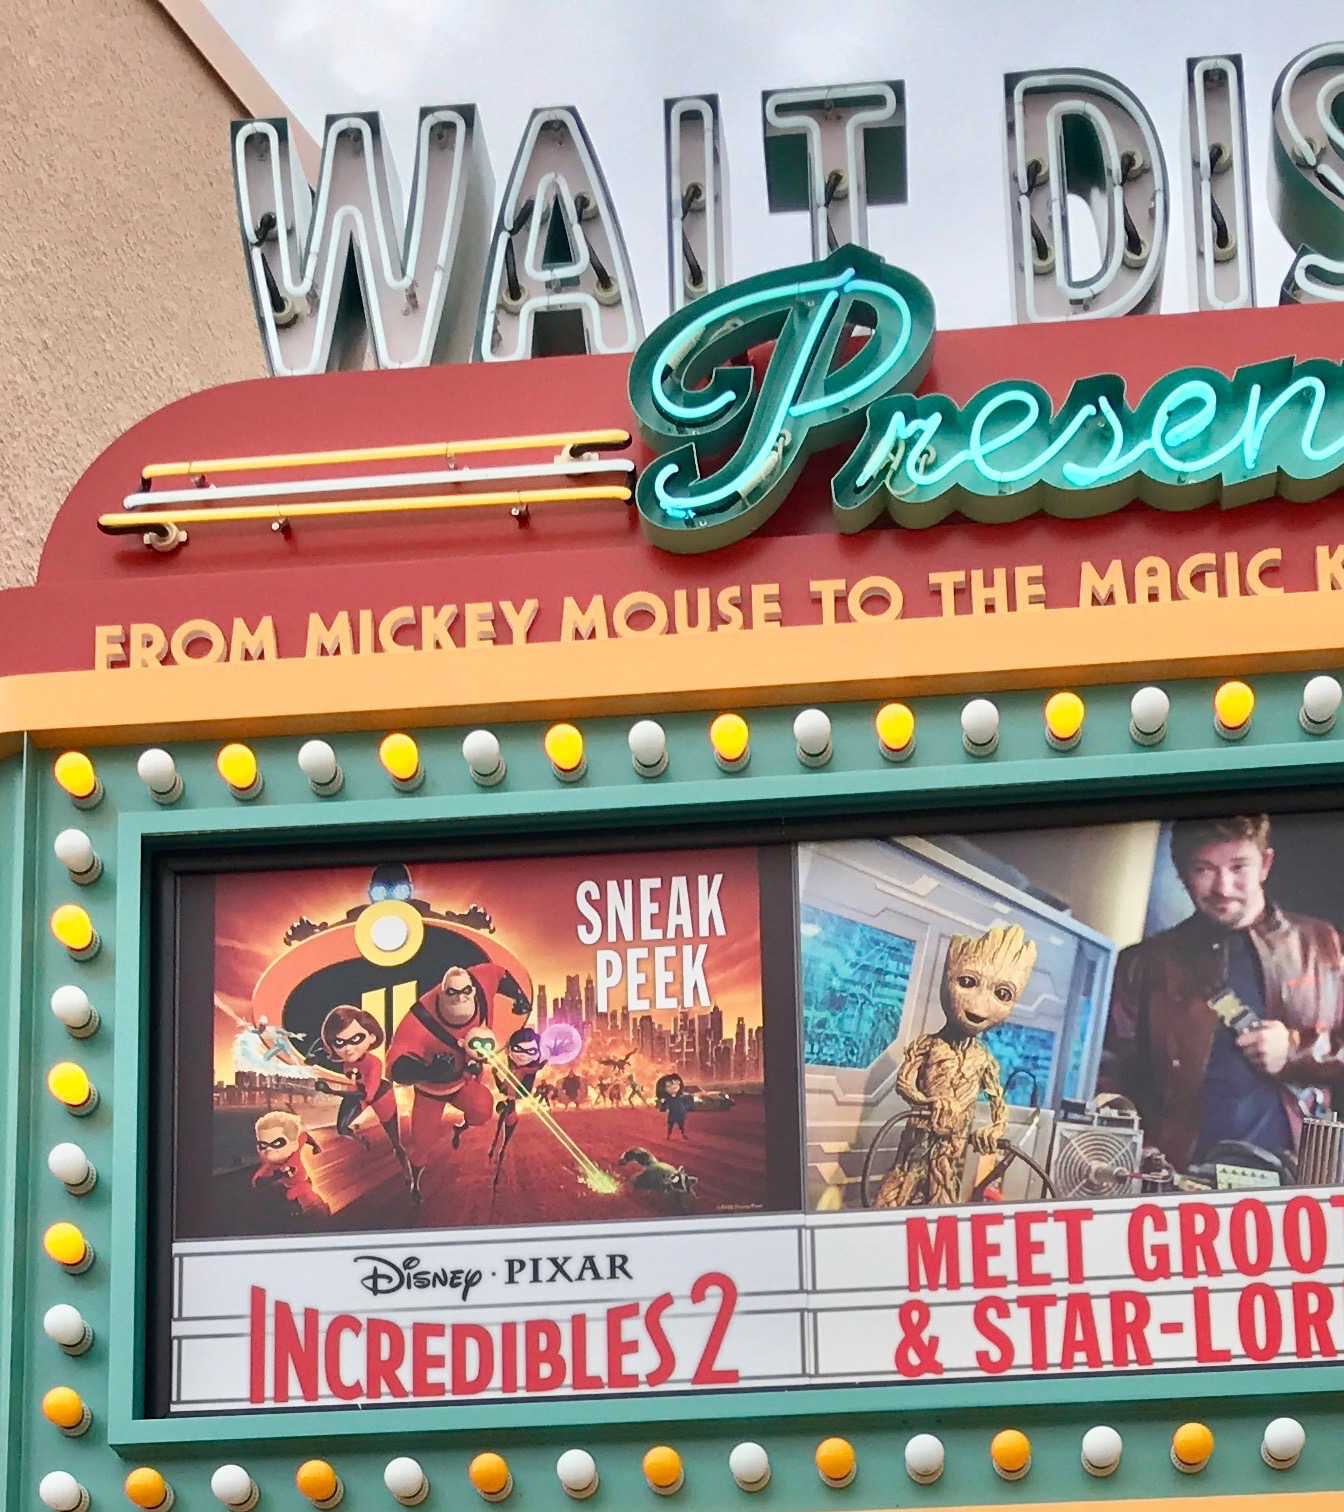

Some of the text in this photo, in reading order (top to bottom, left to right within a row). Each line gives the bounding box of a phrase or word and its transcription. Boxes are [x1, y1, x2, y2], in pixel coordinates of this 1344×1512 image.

[94, 614, 277, 670] FROM
[304, 598, 540, 660] MICKEY
[560, 582, 782, 643] MOUSE
[809, 575, 904, 625] TO
[928, 564, 1046, 618] THE
[1078, 547, 1285, 608] MAGIC
[575, 873, 727, 944] SNEAK
[596, 944, 712, 1013] PEEK
[503, 1252, 635, 1286] PIXAR
[904, 1208, 1094, 1293] MEET
[249, 1271, 740, 1405] INCREDIBLES 2
[894, 1298, 945, 1379] &
